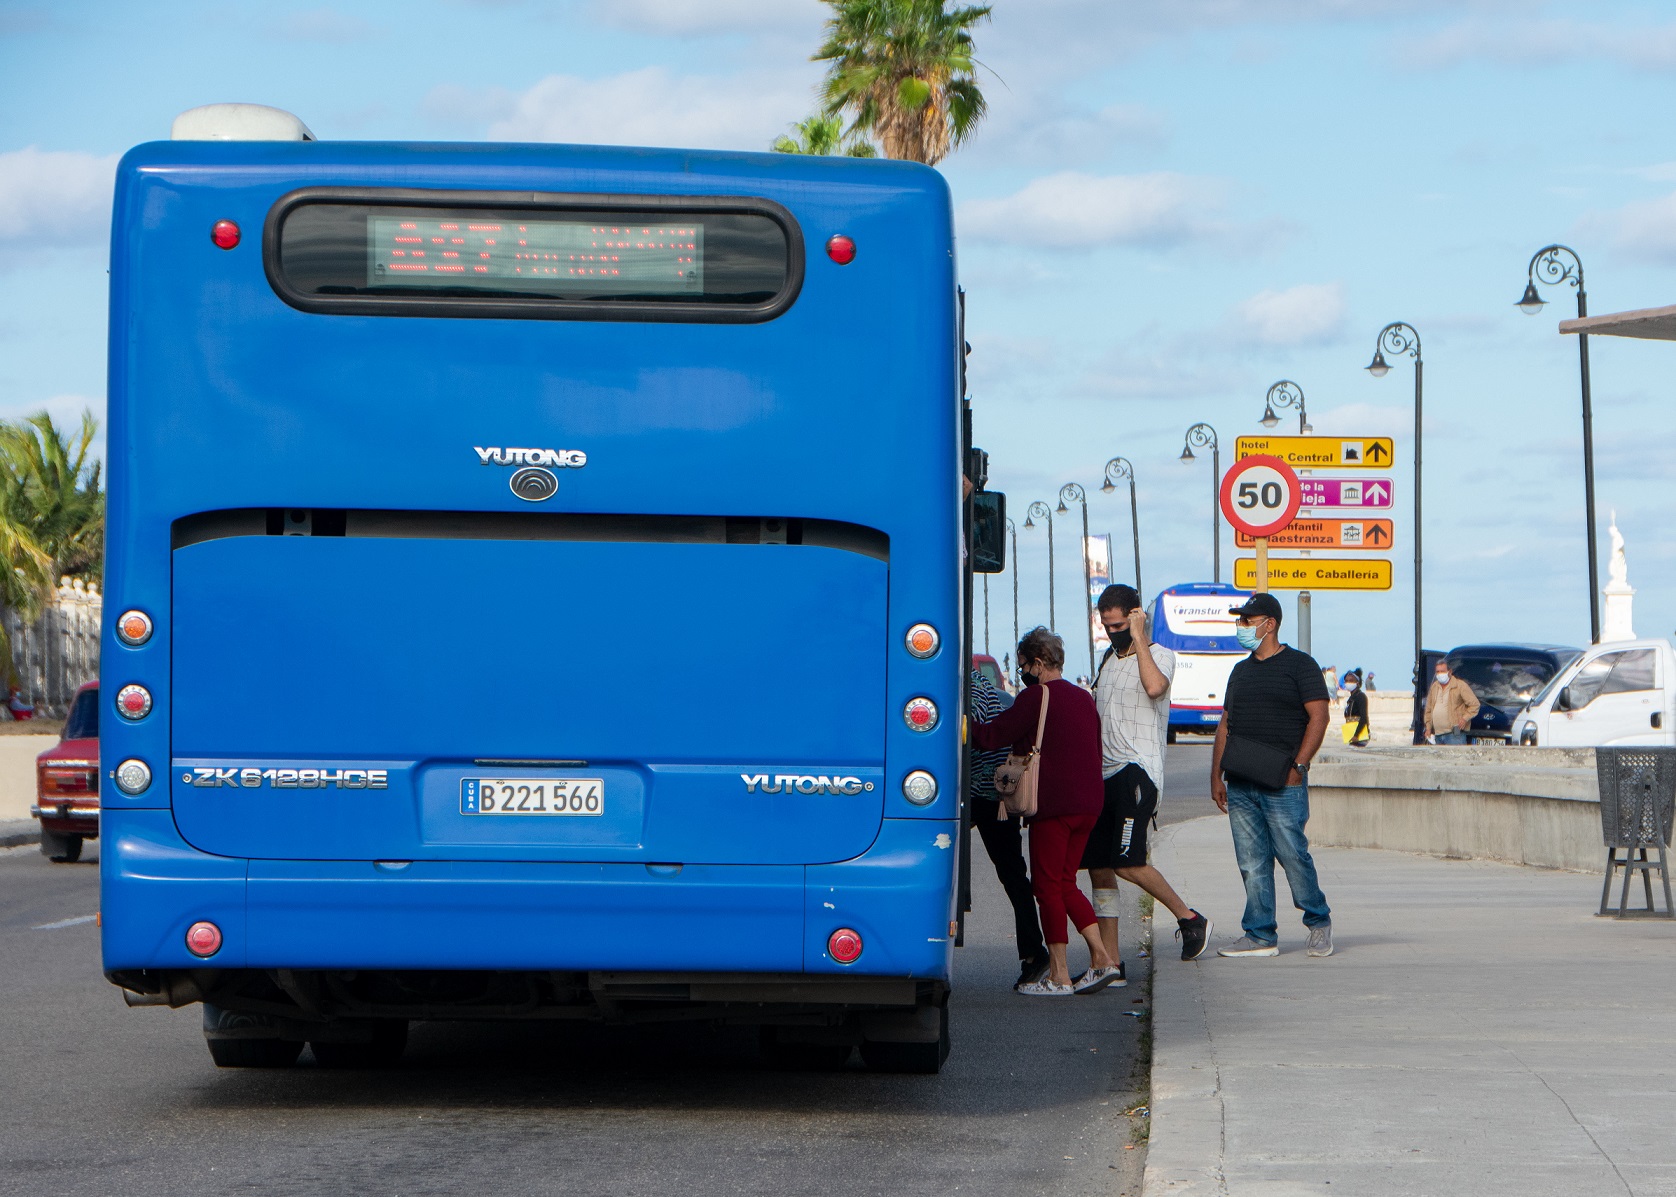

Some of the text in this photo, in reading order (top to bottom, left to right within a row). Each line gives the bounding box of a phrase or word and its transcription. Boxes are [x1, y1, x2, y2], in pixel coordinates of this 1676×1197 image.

[1241, 441, 1269, 449] hotel
[473, 446, 587, 468] YUTONG
[1287, 452, 1333, 462] Central
[1314, 482, 1324, 491] la
[1238, 481, 1283, 509] 50
[1299, 493, 1326, 506] ieja
[1241, 533, 1256, 542] La
[1266, 534, 1334, 543] aestranza
[1246, 569, 1379, 579] melle de Caballería
[740, 774, 862, 795] YUTONG
[467, 782, 475, 809] CUBA
[1121, 817, 1135, 847] PUMA
